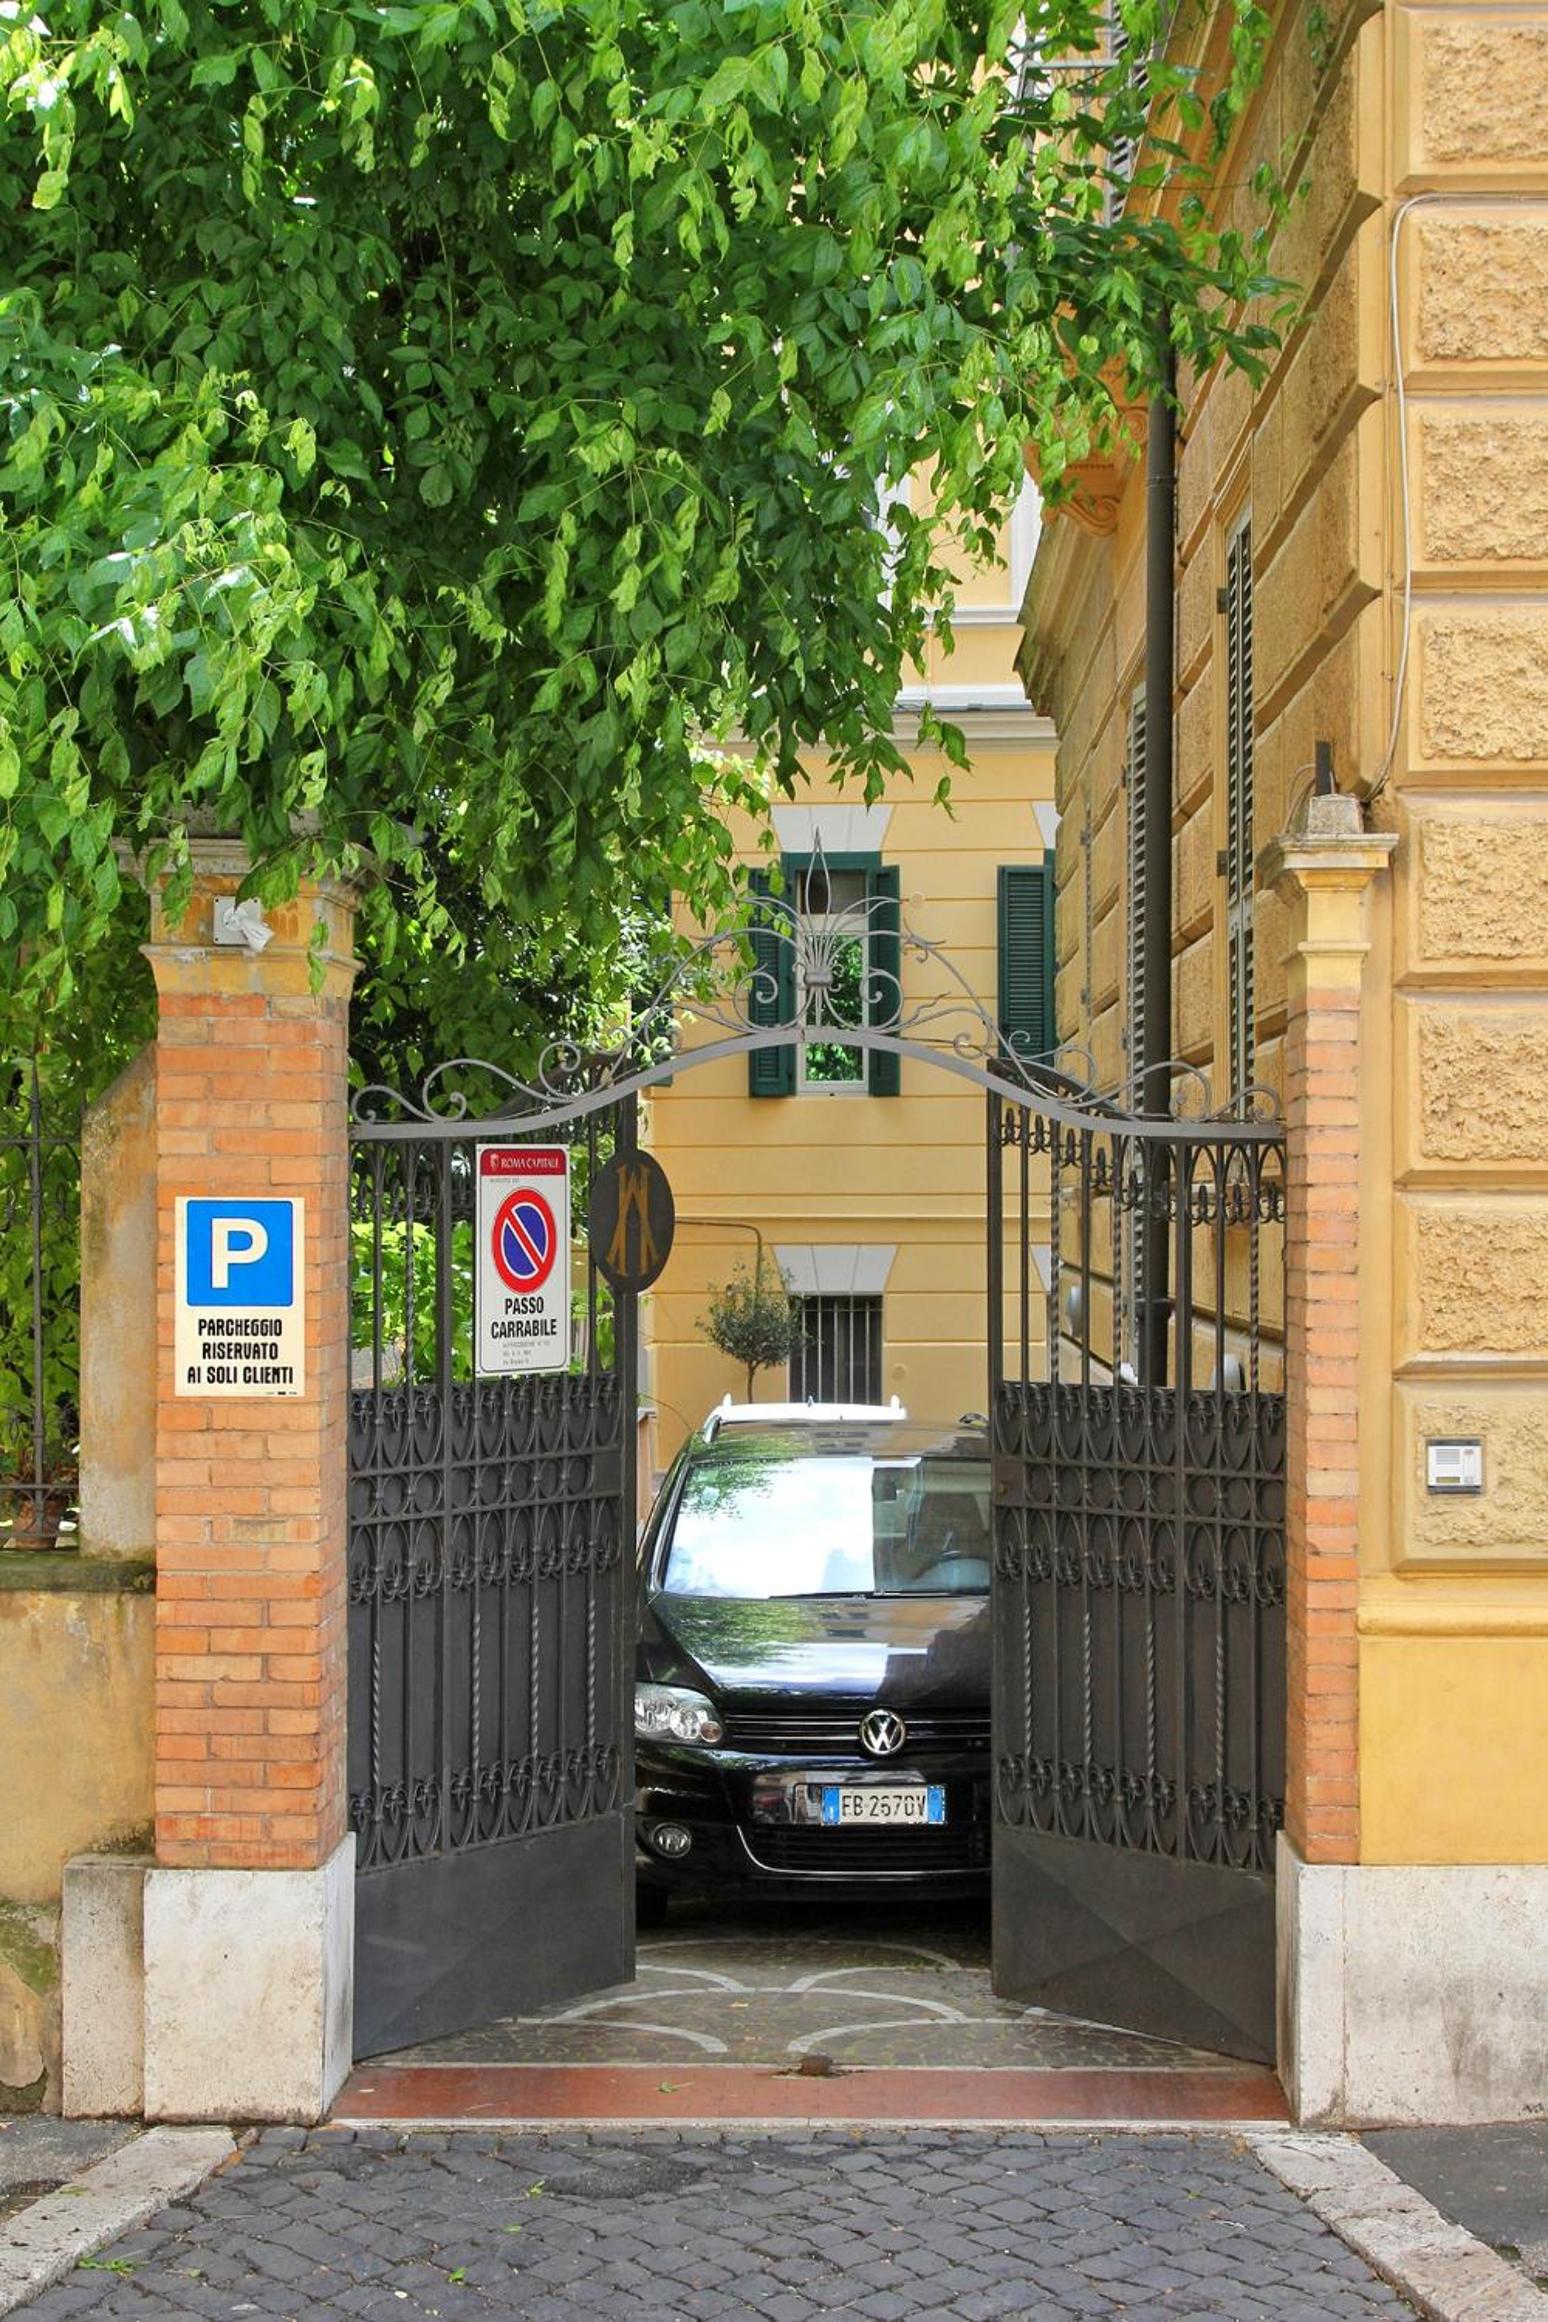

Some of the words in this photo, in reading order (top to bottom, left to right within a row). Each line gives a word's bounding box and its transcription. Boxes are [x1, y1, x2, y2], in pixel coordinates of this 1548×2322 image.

[501, 1157, 526, 1168] ROMA
[527, 1157, 559, 1168] CAPITALE
[211, 1217, 269, 1289] P
[505, 1296, 544, 1315] PASSO
[198, 1318, 283, 1337] PARCHEGGIO
[491, 1319, 557, 1339] CARRABILE
[202, 1342, 279, 1360] RISERVATO
[187, 1366, 201, 1384] AI
[207, 1366, 238, 1384] SOLI
[243, 1366, 293, 1384] CLIENTI
